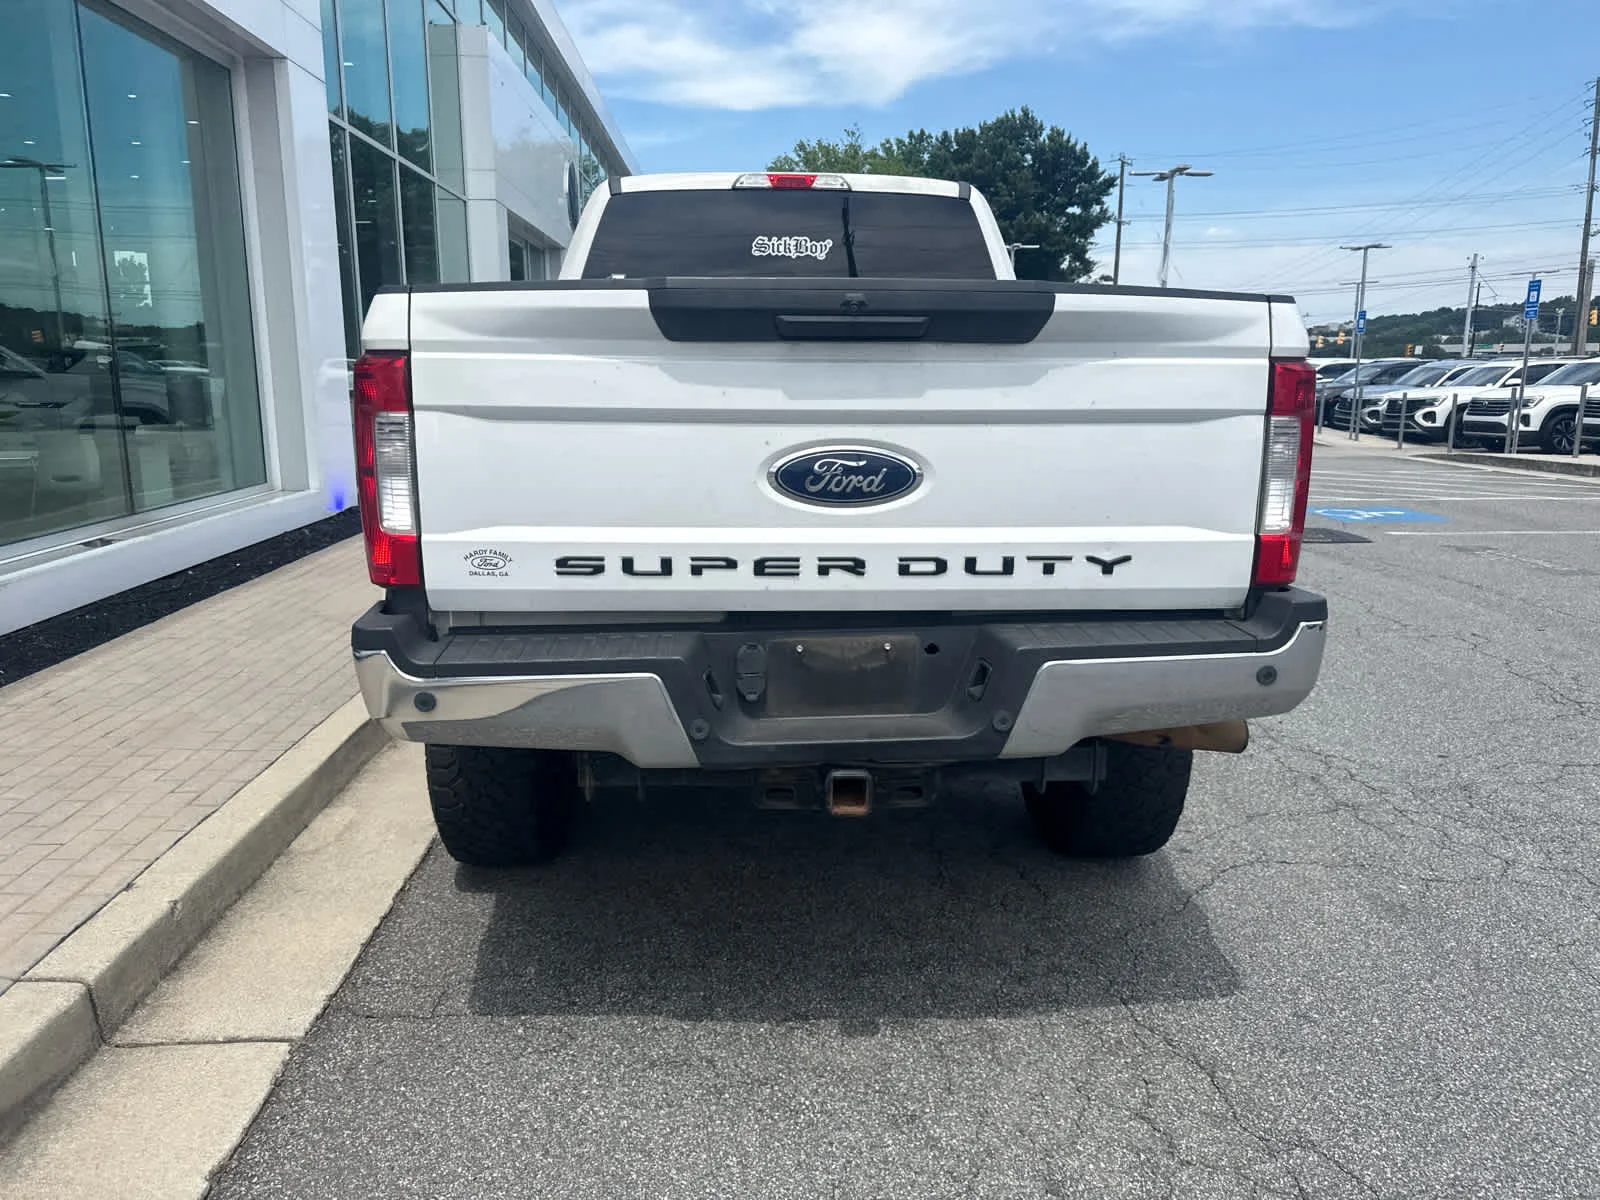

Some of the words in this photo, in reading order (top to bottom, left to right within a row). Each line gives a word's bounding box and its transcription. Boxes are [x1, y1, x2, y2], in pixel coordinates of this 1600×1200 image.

[752, 236, 832, 260] SickBoy
[805, 458, 887, 492] Ford
[463, 549, 488, 561] HARDY
[488, 549, 513, 563] FAMILY
[477, 558, 500, 568] Ford
[554, 556, 867, 577] SUPER
[897, 555, 1133, 577] DUTY
